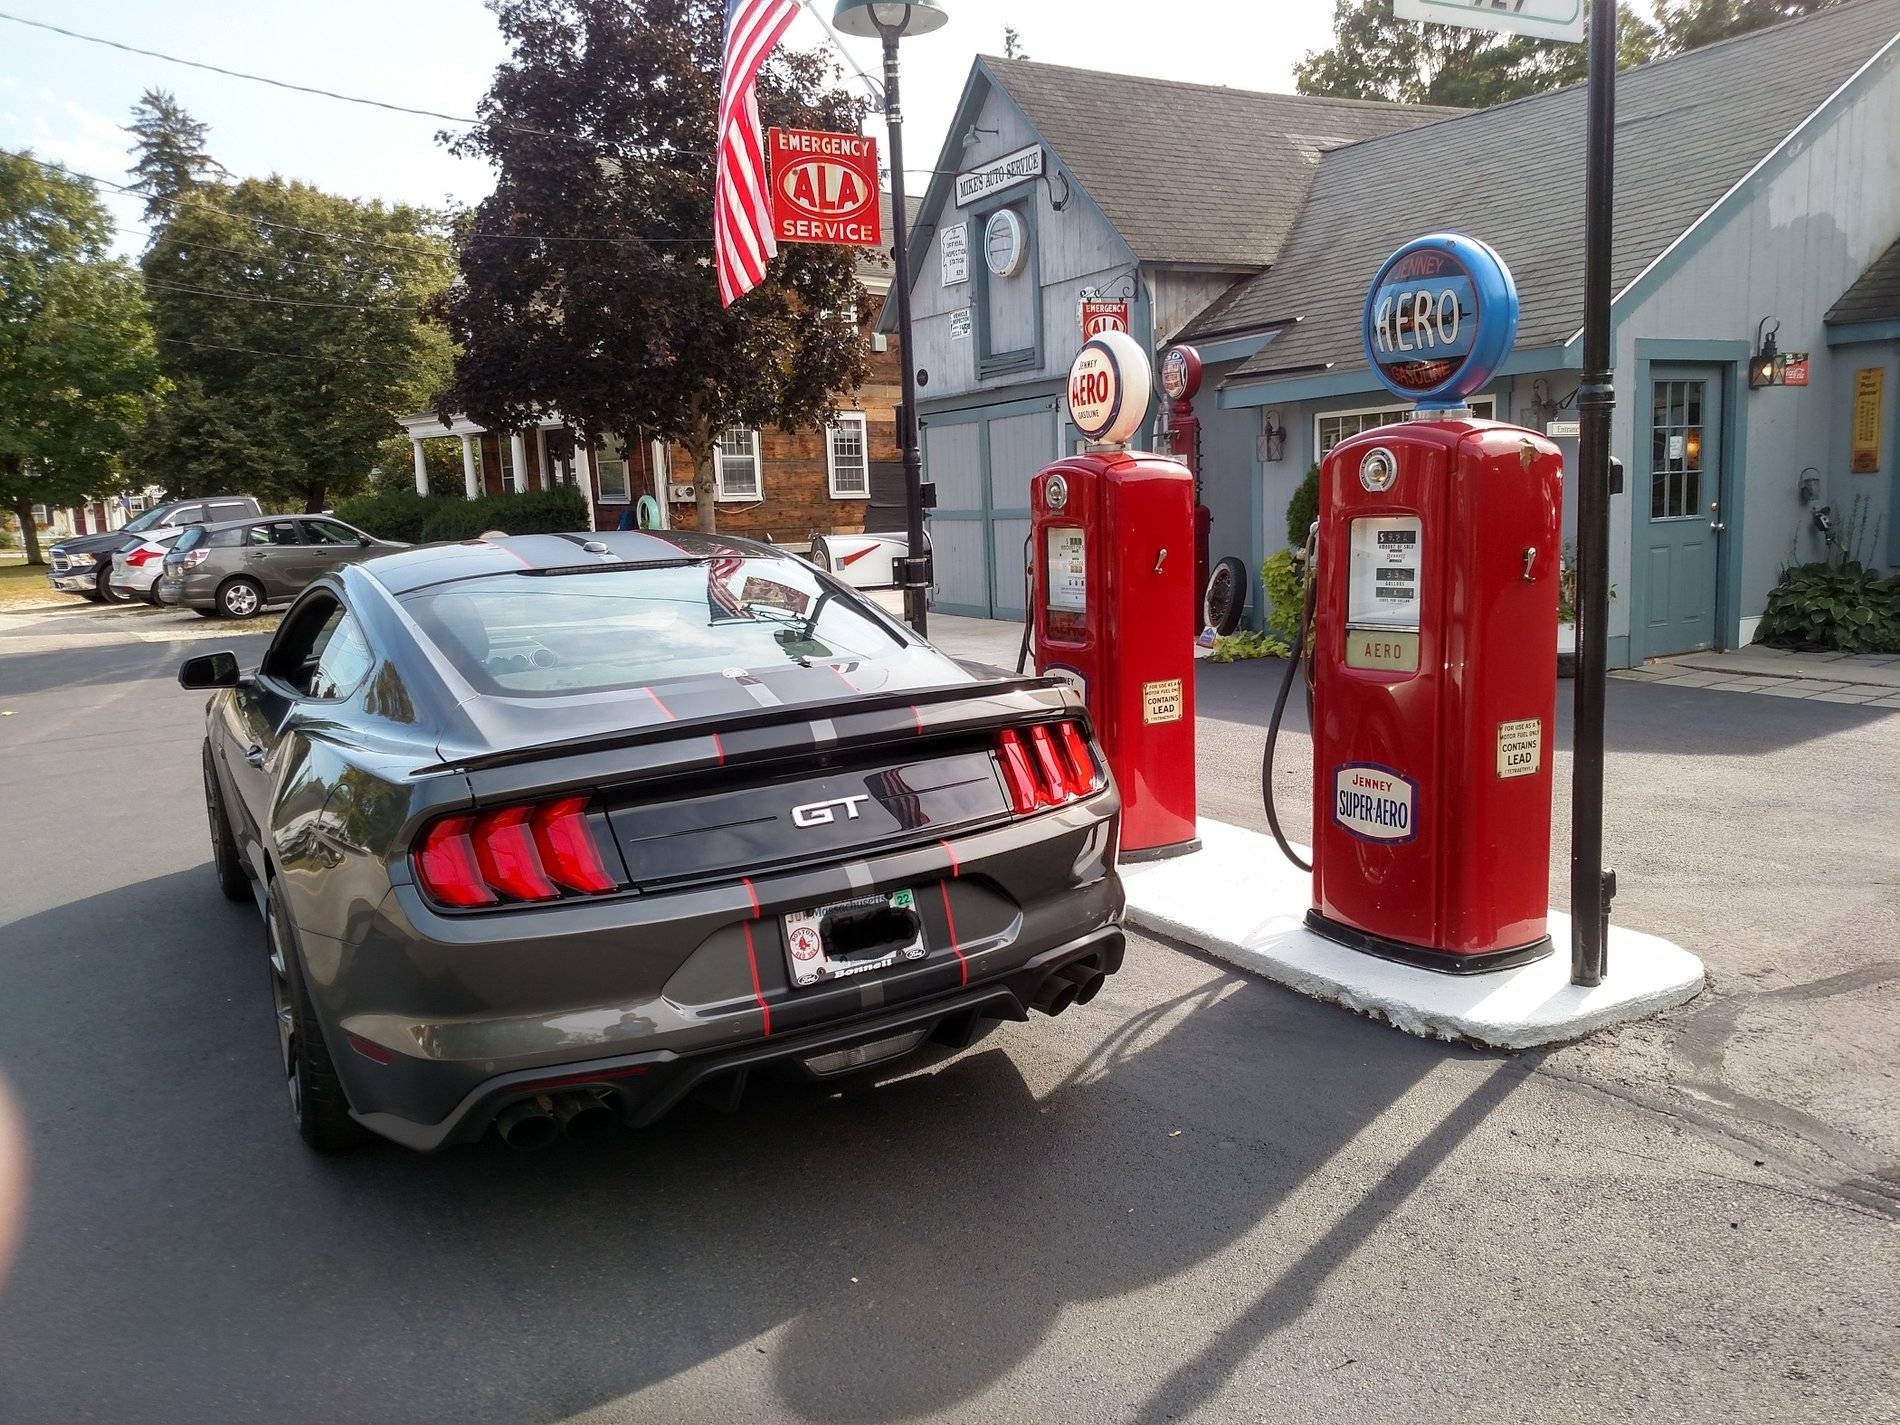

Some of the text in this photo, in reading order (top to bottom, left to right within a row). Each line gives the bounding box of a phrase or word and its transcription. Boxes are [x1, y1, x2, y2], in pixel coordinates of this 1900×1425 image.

[778, 133, 870, 157] EMERGENCY
[985, 165, 1004, 188] AUTO
[1006, 152, 1039, 179] SERVICE
[792, 165, 860, 210] ALA
[782, 219, 873, 241] SERVICE
[1396, 255, 1444, 279] JENNEY
[1086, 304, 1126, 313] EMERGENCY
[1375, 288, 1460, 353] AERO
[1079, 359, 1098, 371] JENNEY
[1391, 360, 1451, 385] GASOLINE
[1072, 370, 1109, 408] AERO
[1077, 408, 1100, 420] GASOLINE
[1364, 642, 1402, 659] AERO
[1147, 694, 1179, 705] CONTAINS
[1152, 704, 1175, 715] LEAD
[1516, 730, 1528, 738] FUEL
[1502, 739, 1537, 752] CONTAINS
[1507, 752, 1532, 766] LEAD
[1352, 773, 1393, 793] JENNEY
[790, 793, 870, 829] GT
[896, 893, 911, 906] 22
[792, 929, 814, 943] BOSTON
[833, 957, 893, 979] Bonnell
